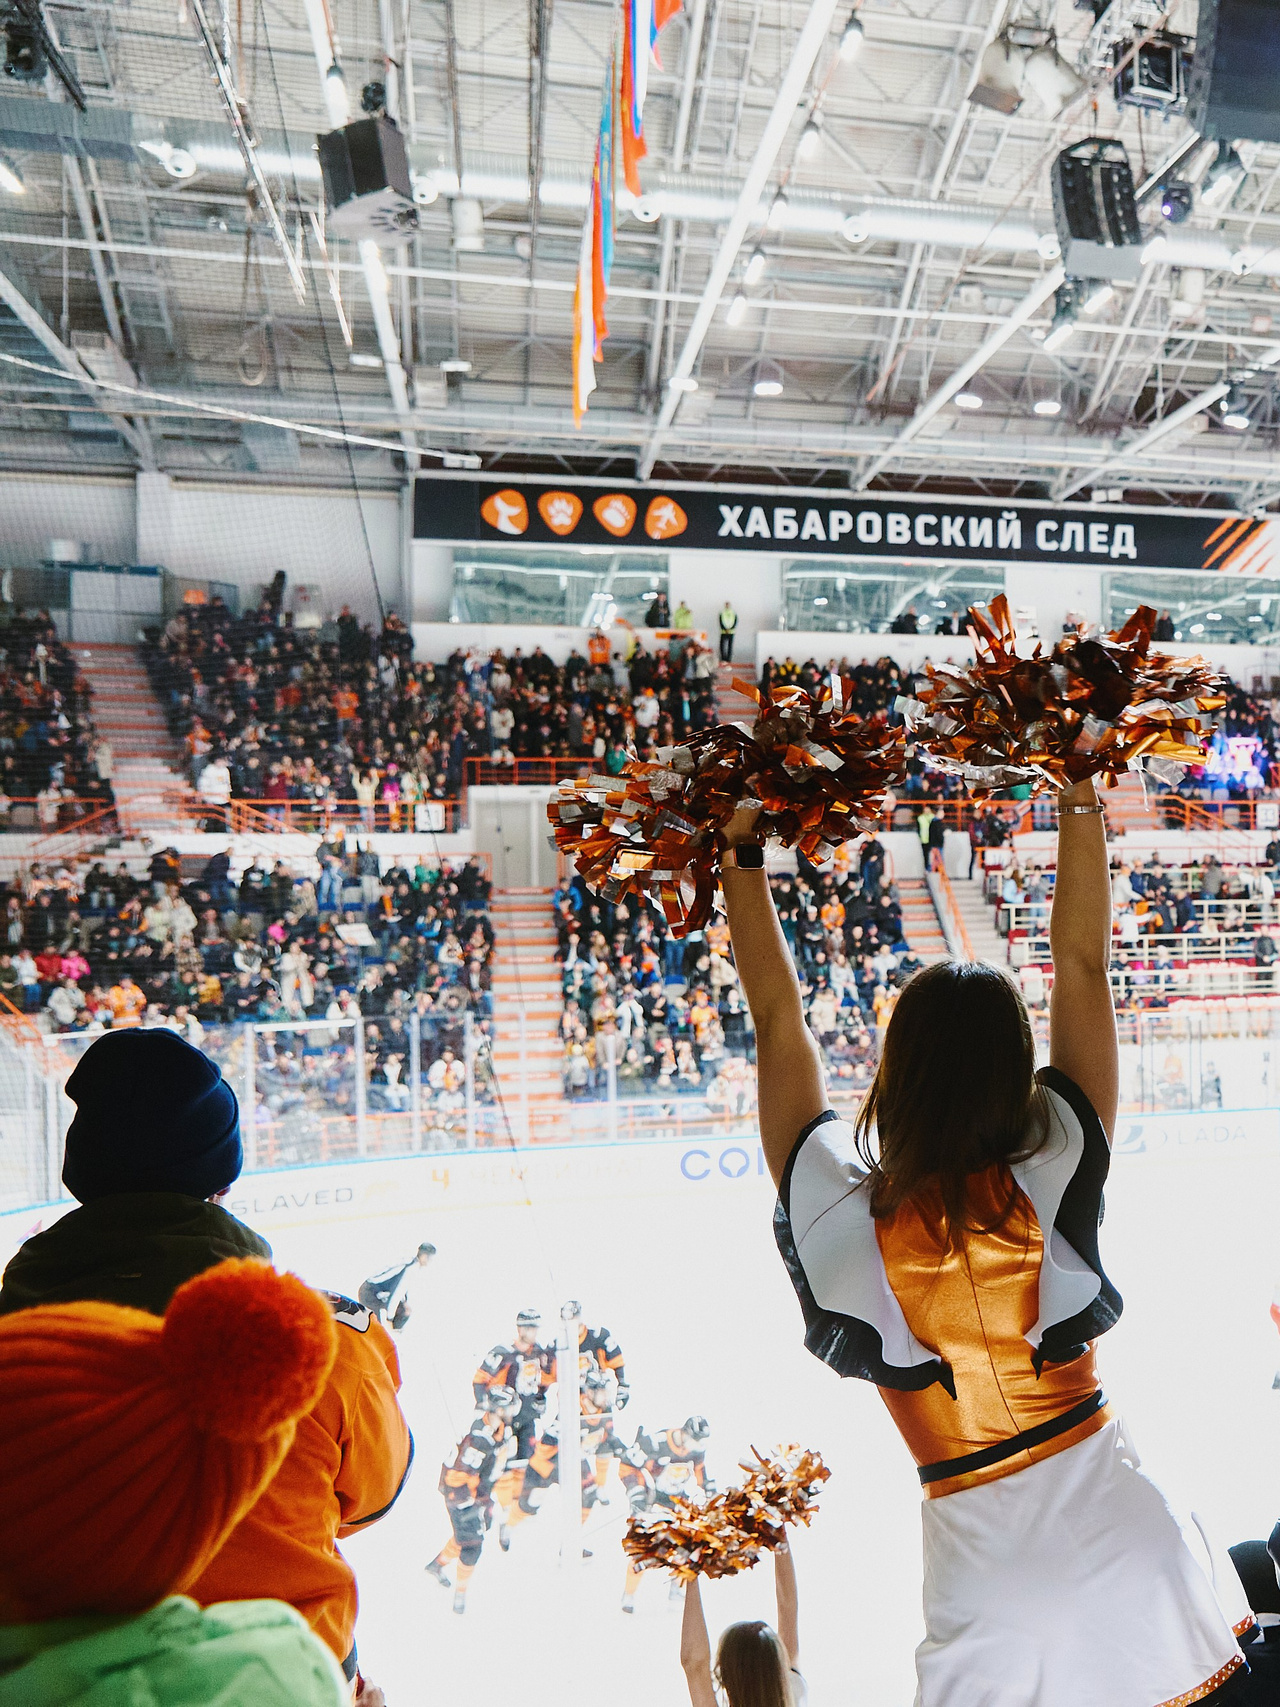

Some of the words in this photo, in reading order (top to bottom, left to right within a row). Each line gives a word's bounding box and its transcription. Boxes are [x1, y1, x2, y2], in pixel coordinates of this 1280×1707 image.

[718, 504, 1022, 549] ХАБАРОВСКИЙ
[1036, 519, 1138, 559] СЛЕД
[1177, 1125, 1247, 1145] LADA
